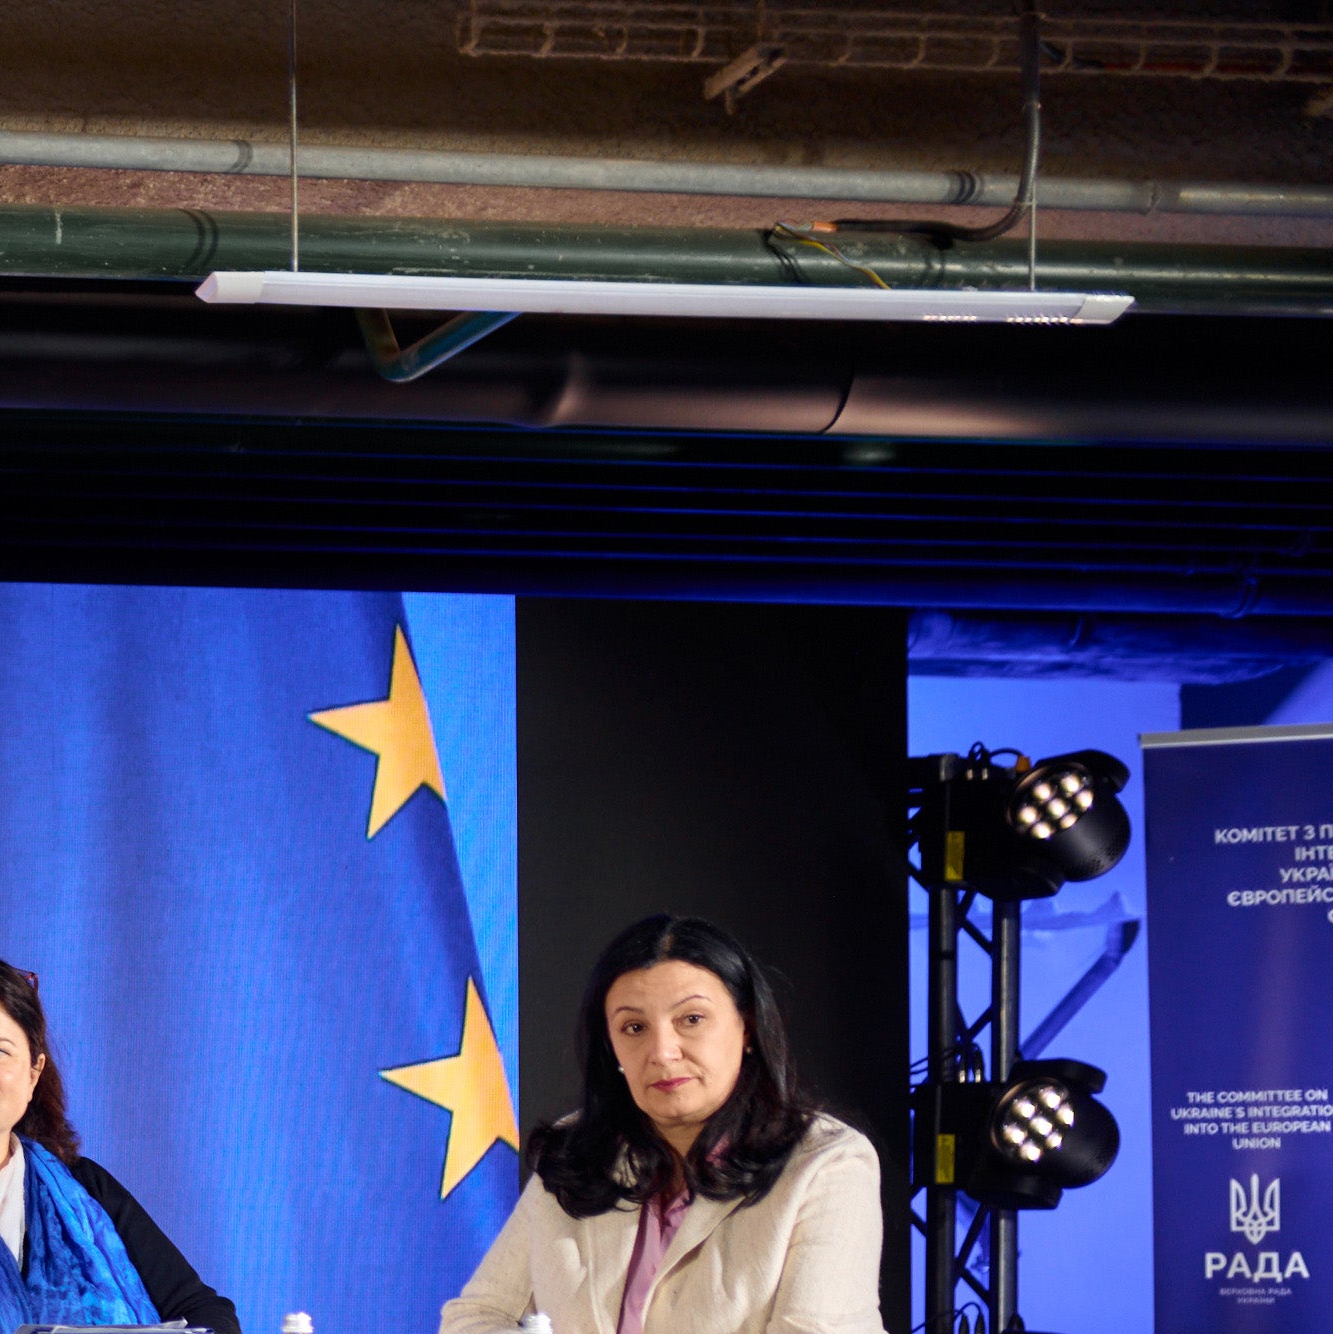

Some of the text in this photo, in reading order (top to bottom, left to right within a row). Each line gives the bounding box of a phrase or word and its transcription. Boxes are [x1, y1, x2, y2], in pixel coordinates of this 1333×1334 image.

[1214, 826, 1299, 844] КОМІТЕТ
[1303, 825, 1315, 840] З
[1187, 1089, 1328, 1104] THE COMMITTEE ON
[1184, 1121, 1331, 1135] INTO THE EUROPEAN
[1232, 1137, 1281, 1149] UNION
[1205, 1251, 1310, 1283] РАДА
